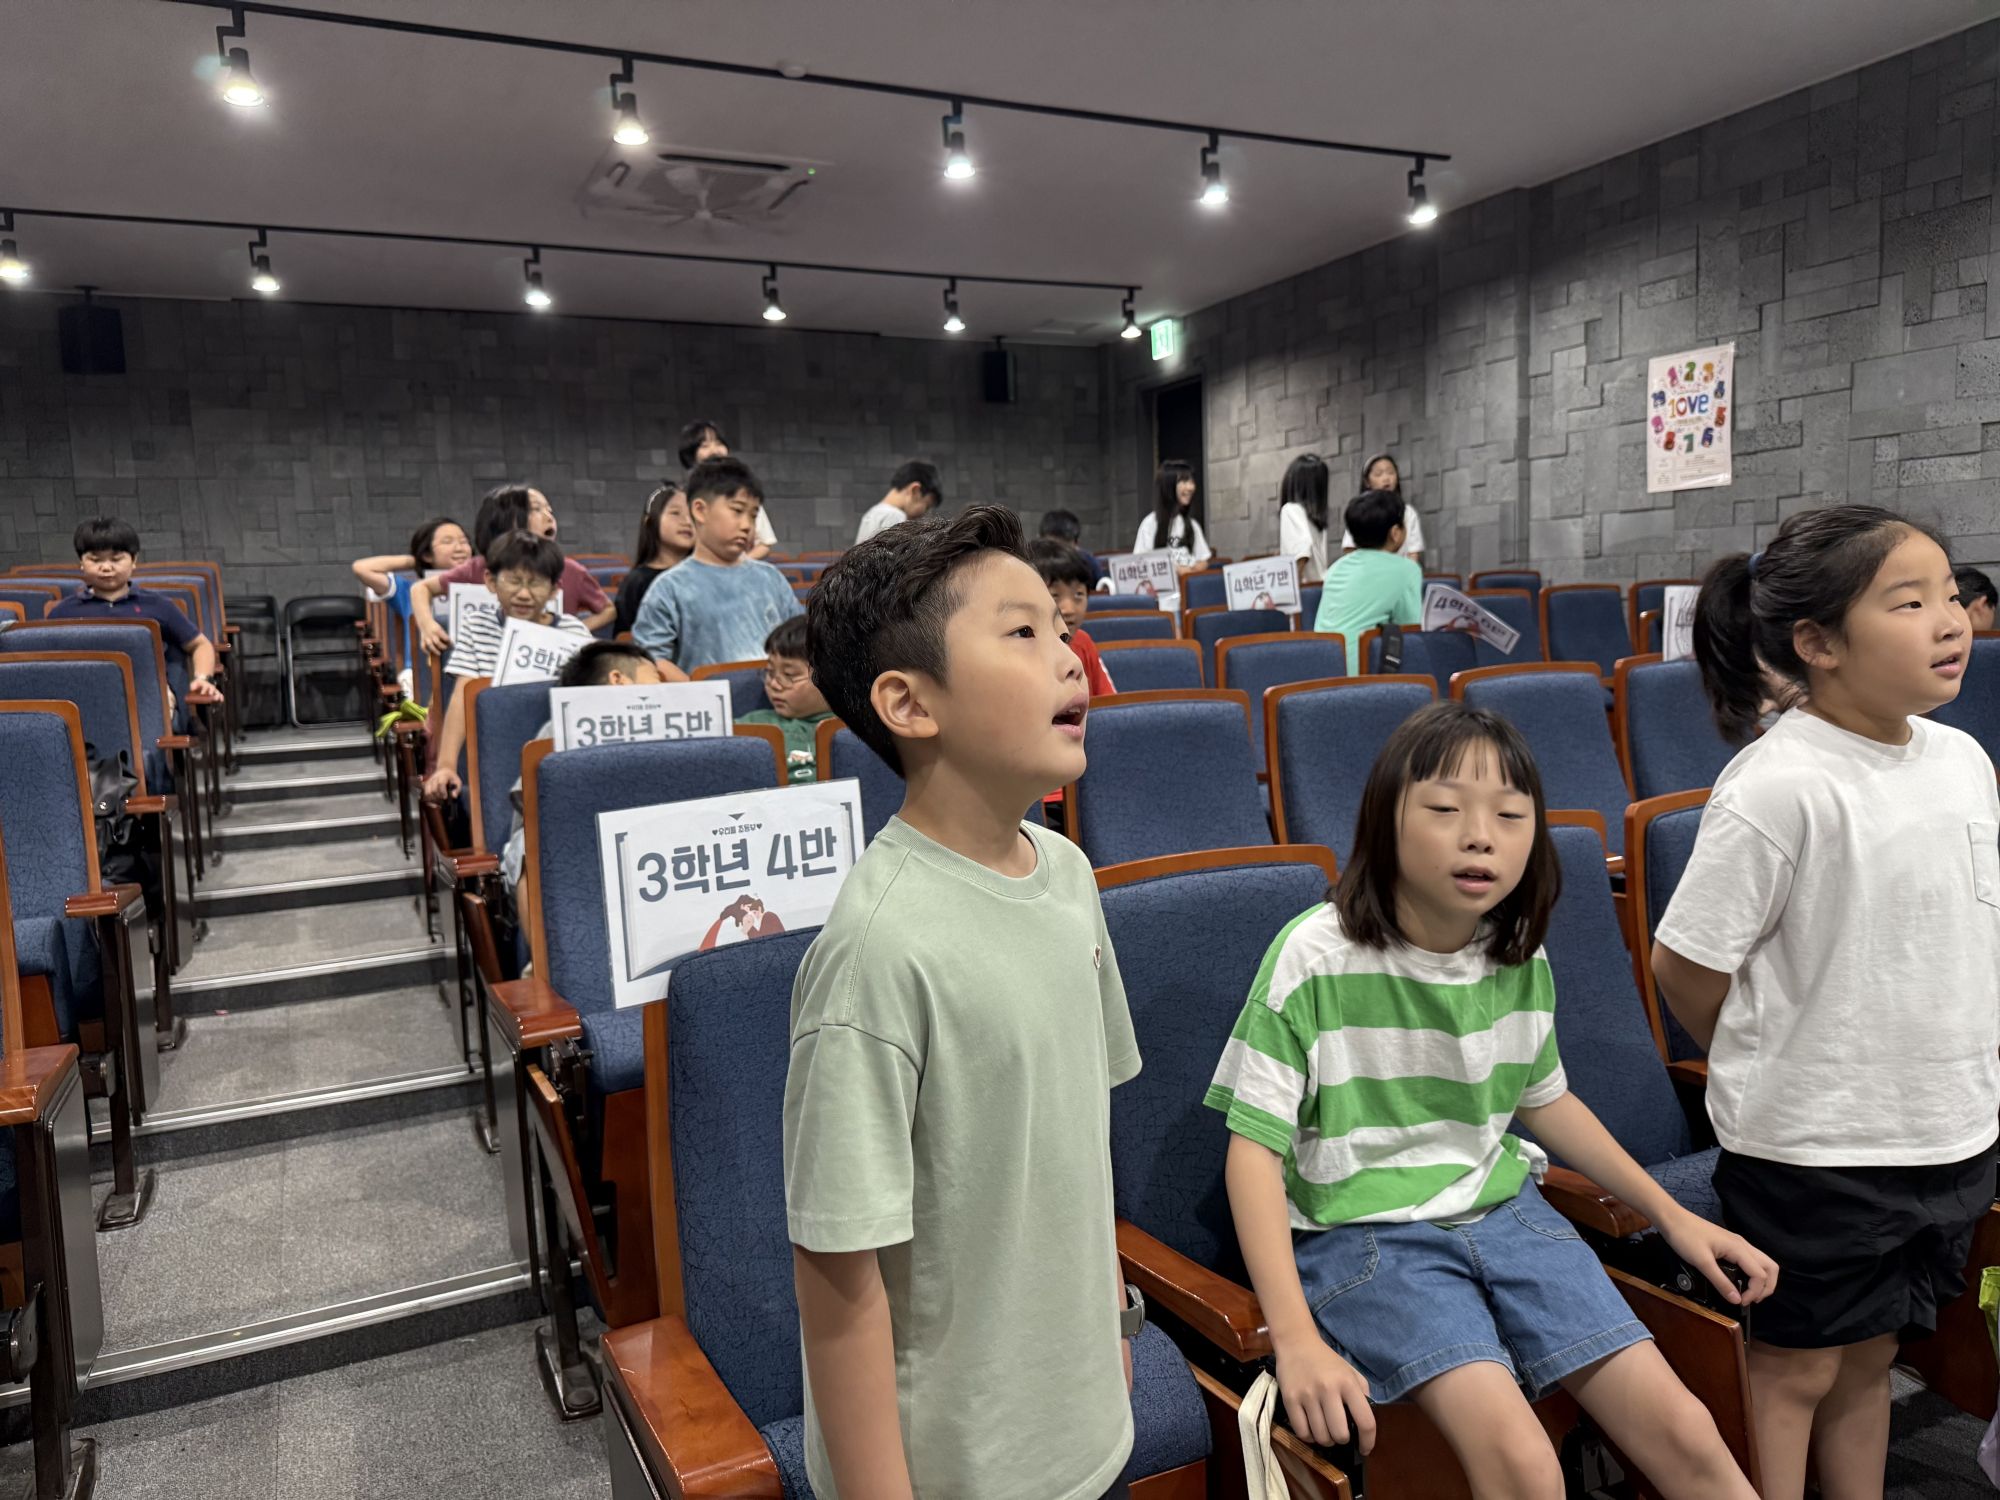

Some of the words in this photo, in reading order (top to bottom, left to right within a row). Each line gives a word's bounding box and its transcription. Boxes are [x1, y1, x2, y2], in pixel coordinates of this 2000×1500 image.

[1684, 361, 1697, 382] 2
[1703, 362, 1715, 383] 3
[1118, 564, 1149, 582] 4학년
[1234, 573, 1265, 593] 4학년
[1267, 569, 1289, 588] 7반
[576, 713, 653, 748] 3학년
[664, 710, 713, 739] 5반
[637, 838, 751, 903] 3학년
[766, 826, 838, 880] 4반
